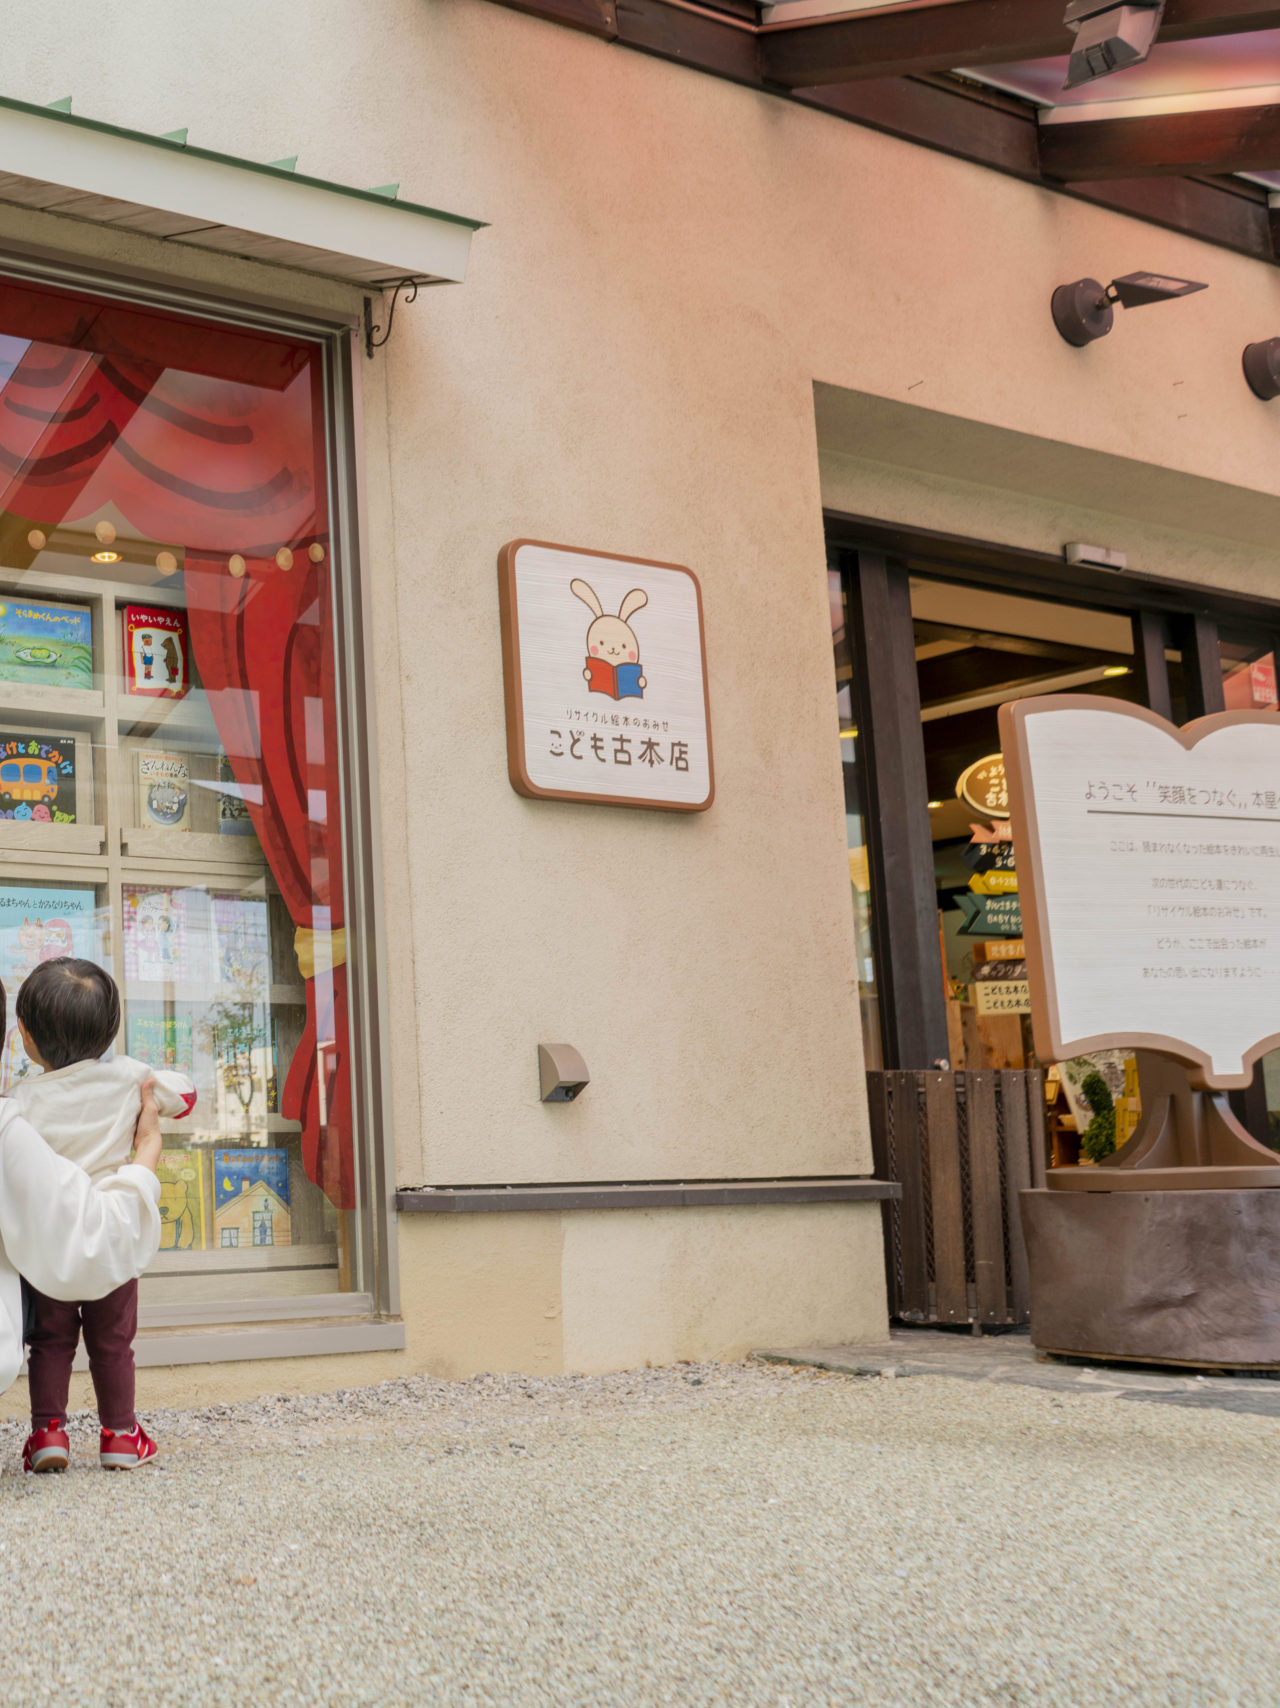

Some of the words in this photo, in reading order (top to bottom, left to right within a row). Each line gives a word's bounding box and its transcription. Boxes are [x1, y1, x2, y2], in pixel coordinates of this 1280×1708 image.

[131, 613, 180, 628] いやいやえん
[566, 709, 669, 732] リサイクル絵本のおみせ
[549, 729, 689, 772] こども古本店
[141, 760, 189, 778] ざんねんな
